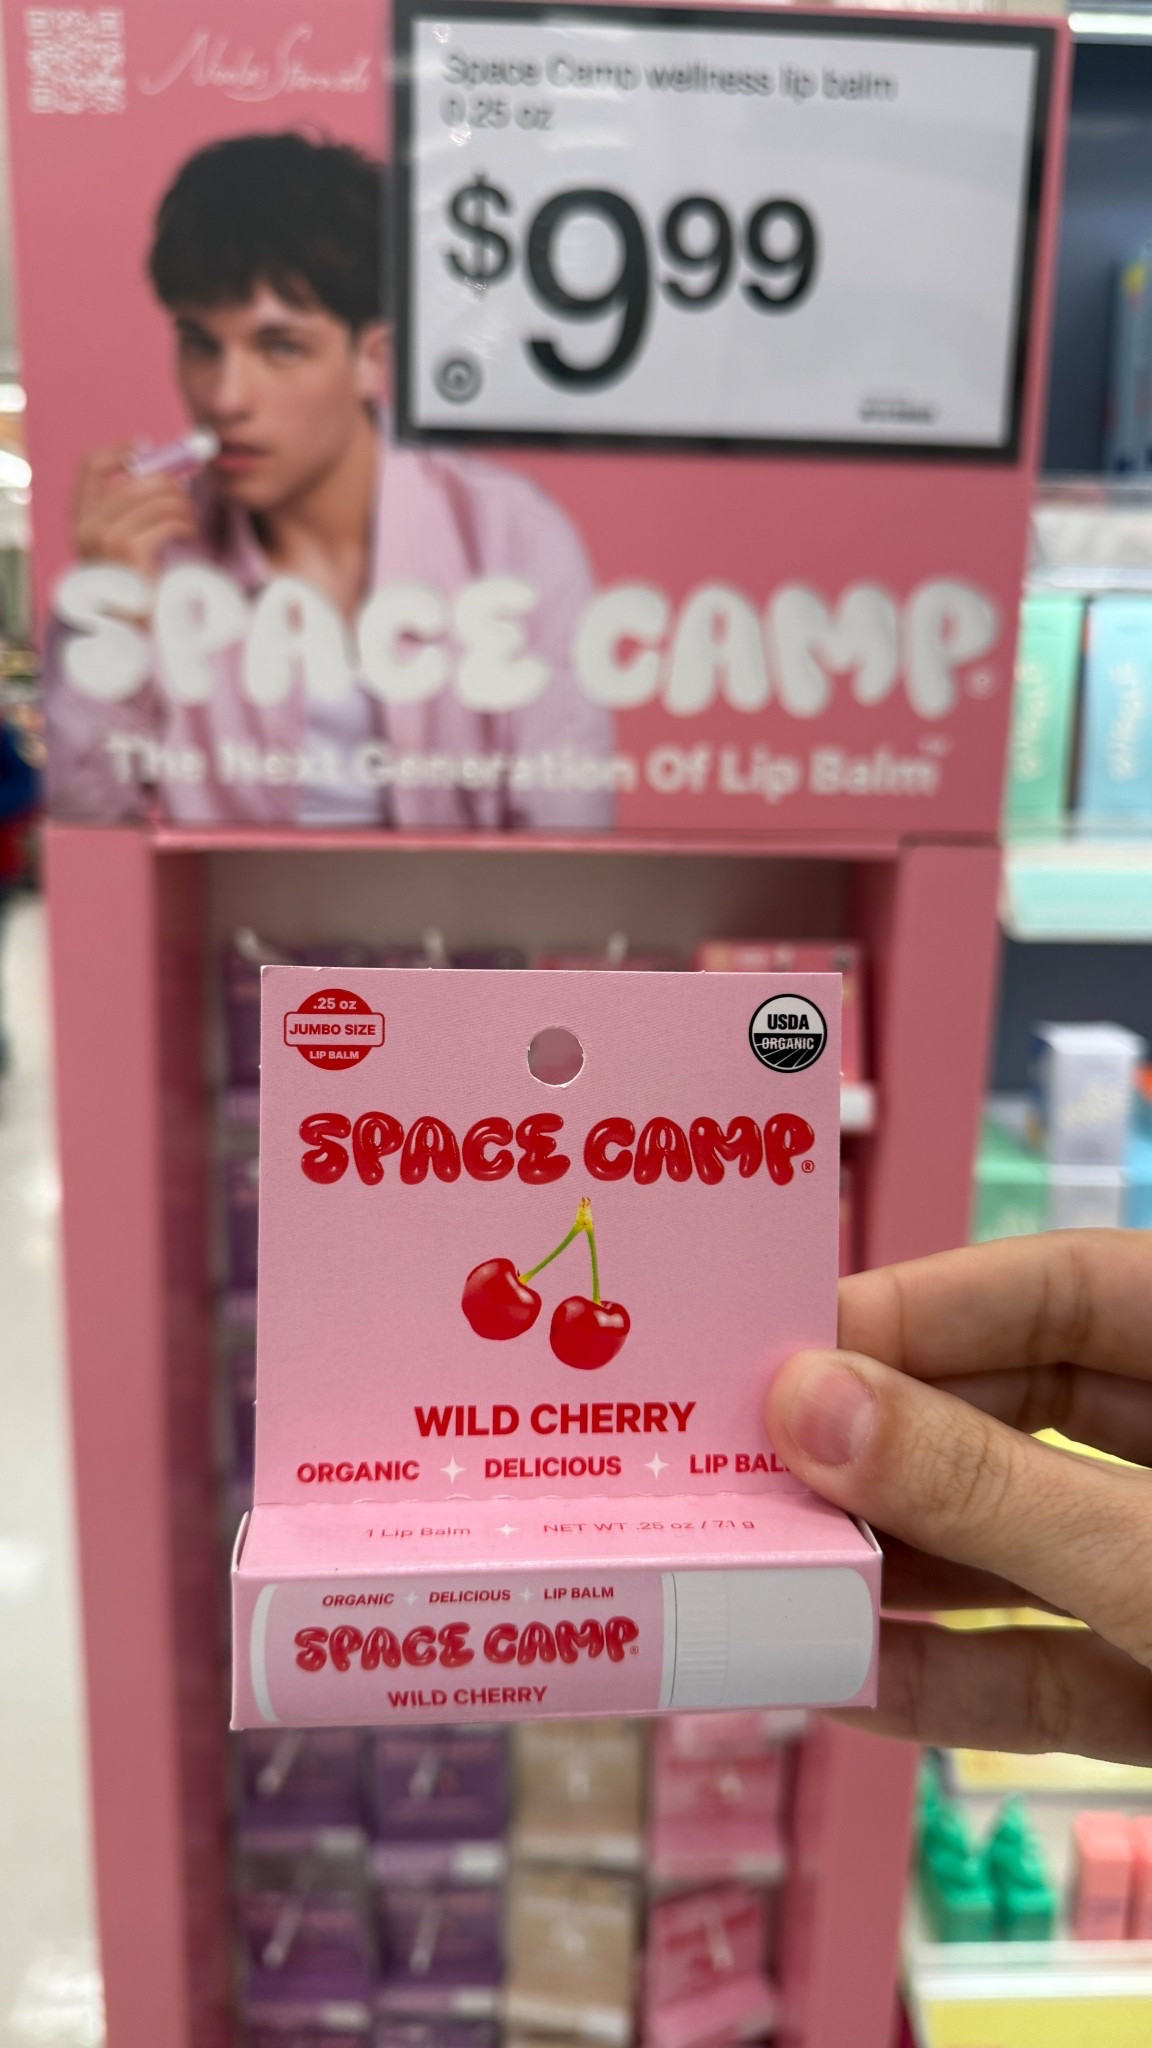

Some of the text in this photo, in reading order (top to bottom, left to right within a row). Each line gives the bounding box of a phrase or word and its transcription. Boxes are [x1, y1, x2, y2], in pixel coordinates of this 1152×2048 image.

[443, 52, 898, 104] Space Camp wellness lip balm
[514, 101, 555, 130] oz
[55, 564, 550, 713] SPACE
[106, 733, 206, 784] The
[218, 742, 337, 788] Next
[352, 740, 637, 794] Generation
[646, 744, 712, 794] Of
[718, 744, 800, 804] Lip
[313, 997, 357, 1010] .25 oz
[289, 1023, 376, 1035] JUMBO SIZE
[767, 1013, 809, 1030] USDA
[309, 1051, 359, 1060] LIP BALM
[762, 1037, 814, 1050] ORGANIC
[300, 1111, 571, 1186] SPACE
[414, 1401, 696, 1437] WILD CHERRY
[296, 1452, 790, 1483] ORGANIC DELICIOUS LIP BAL
[365, 1528, 373, 1537] 1
[381, 1528, 414, 1538] Lip
[420, 1526, 471, 1536] Balm
[543, 1523, 586, 1534] NET
[593, 1522, 627, 1532] WT
[636, 1521, 664, 1530] .25
[670, 1522, 694, 1530] oz
[742, 1521, 755, 1529] g
[322, 1586, 615, 1607] ORGANIC DELICIOUS LIP BALM
[294, 1621, 475, 1672] SPACE
[388, 1685, 548, 1708] WILD CHERRY
